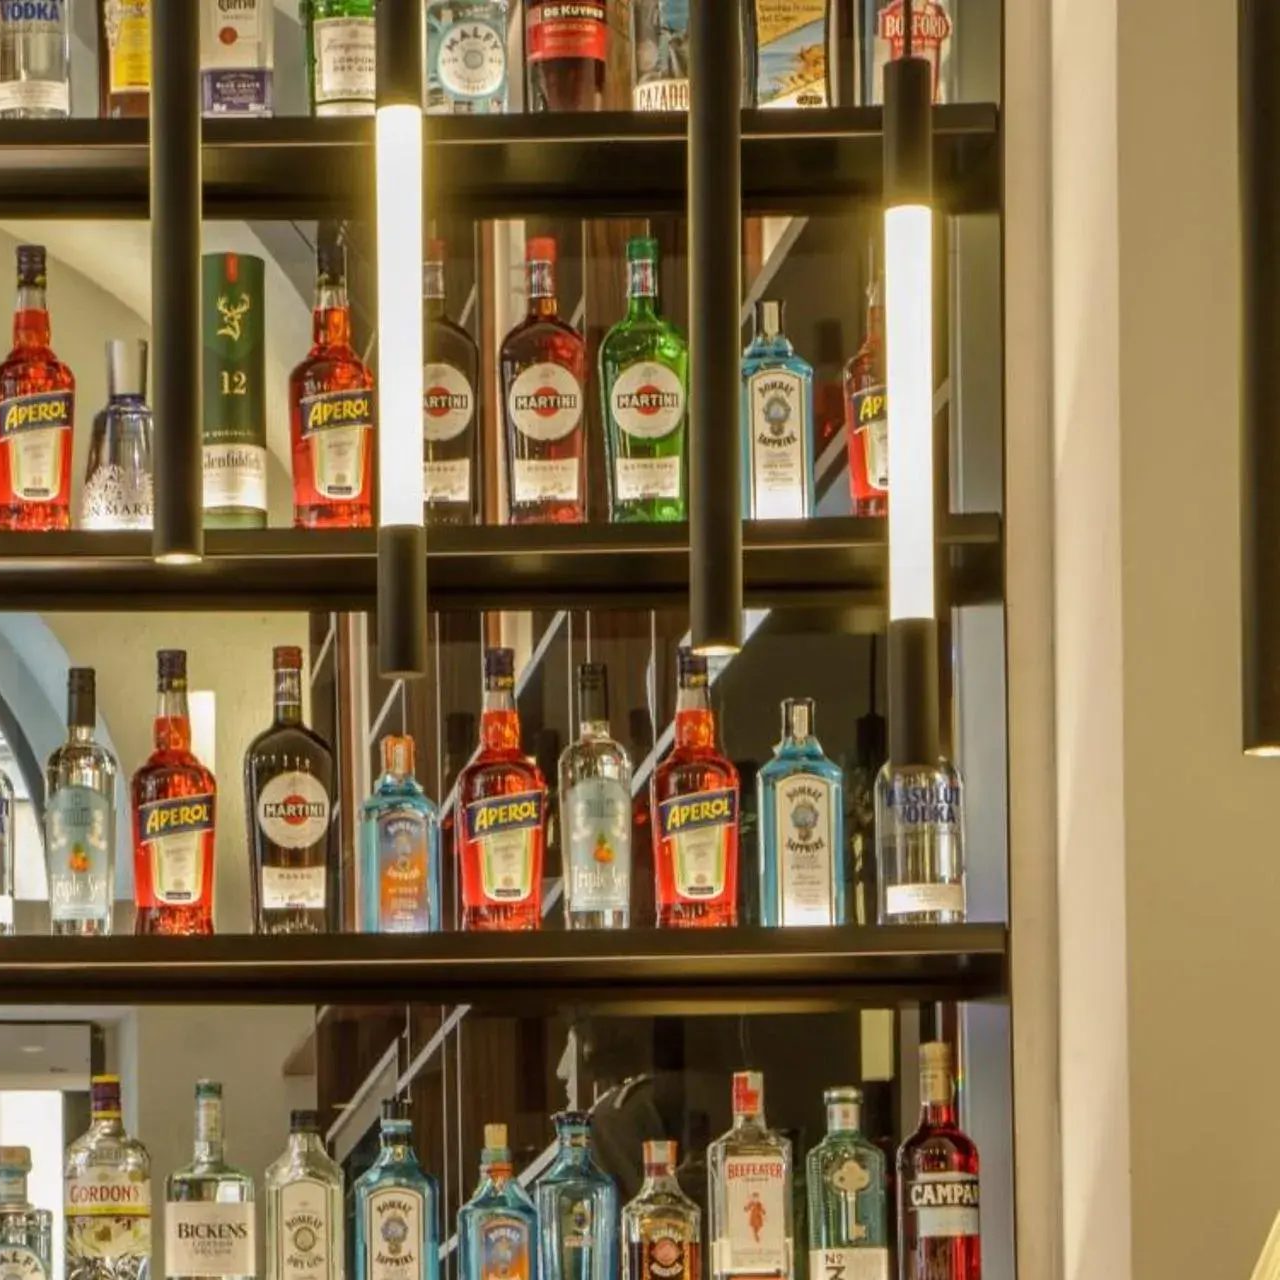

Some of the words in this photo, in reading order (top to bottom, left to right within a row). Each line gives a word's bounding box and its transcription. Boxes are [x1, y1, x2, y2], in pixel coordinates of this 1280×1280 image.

[0, 2, 61, 22] VODKA
[884, 14, 948, 37] BOFORD
[445, 26, 500, 53] MALFY
[639, 82, 689, 111] CAZADO
[220, 371, 247, 395] 12
[424, 395, 467, 409] ARTINI
[516, 395, 577, 409] MARTINI
[618, 394, 678, 408] MARTINI
[5, 400, 68, 430] APEROL
[309, 398, 370, 428] APEROL
[147, 803, 208, 833] APEROL
[265, 804, 324, 818] MARTINI
[475, 802, 538, 831] APEROL
[668, 799, 730, 829] APEROL
[728, 1162, 783, 1181] BEEFEATER
[70, 1184, 140, 1204] GORDON'S
[911, 1183, 980, 1206] CAMPA
[177, 1222, 249, 1239] BICKENS
